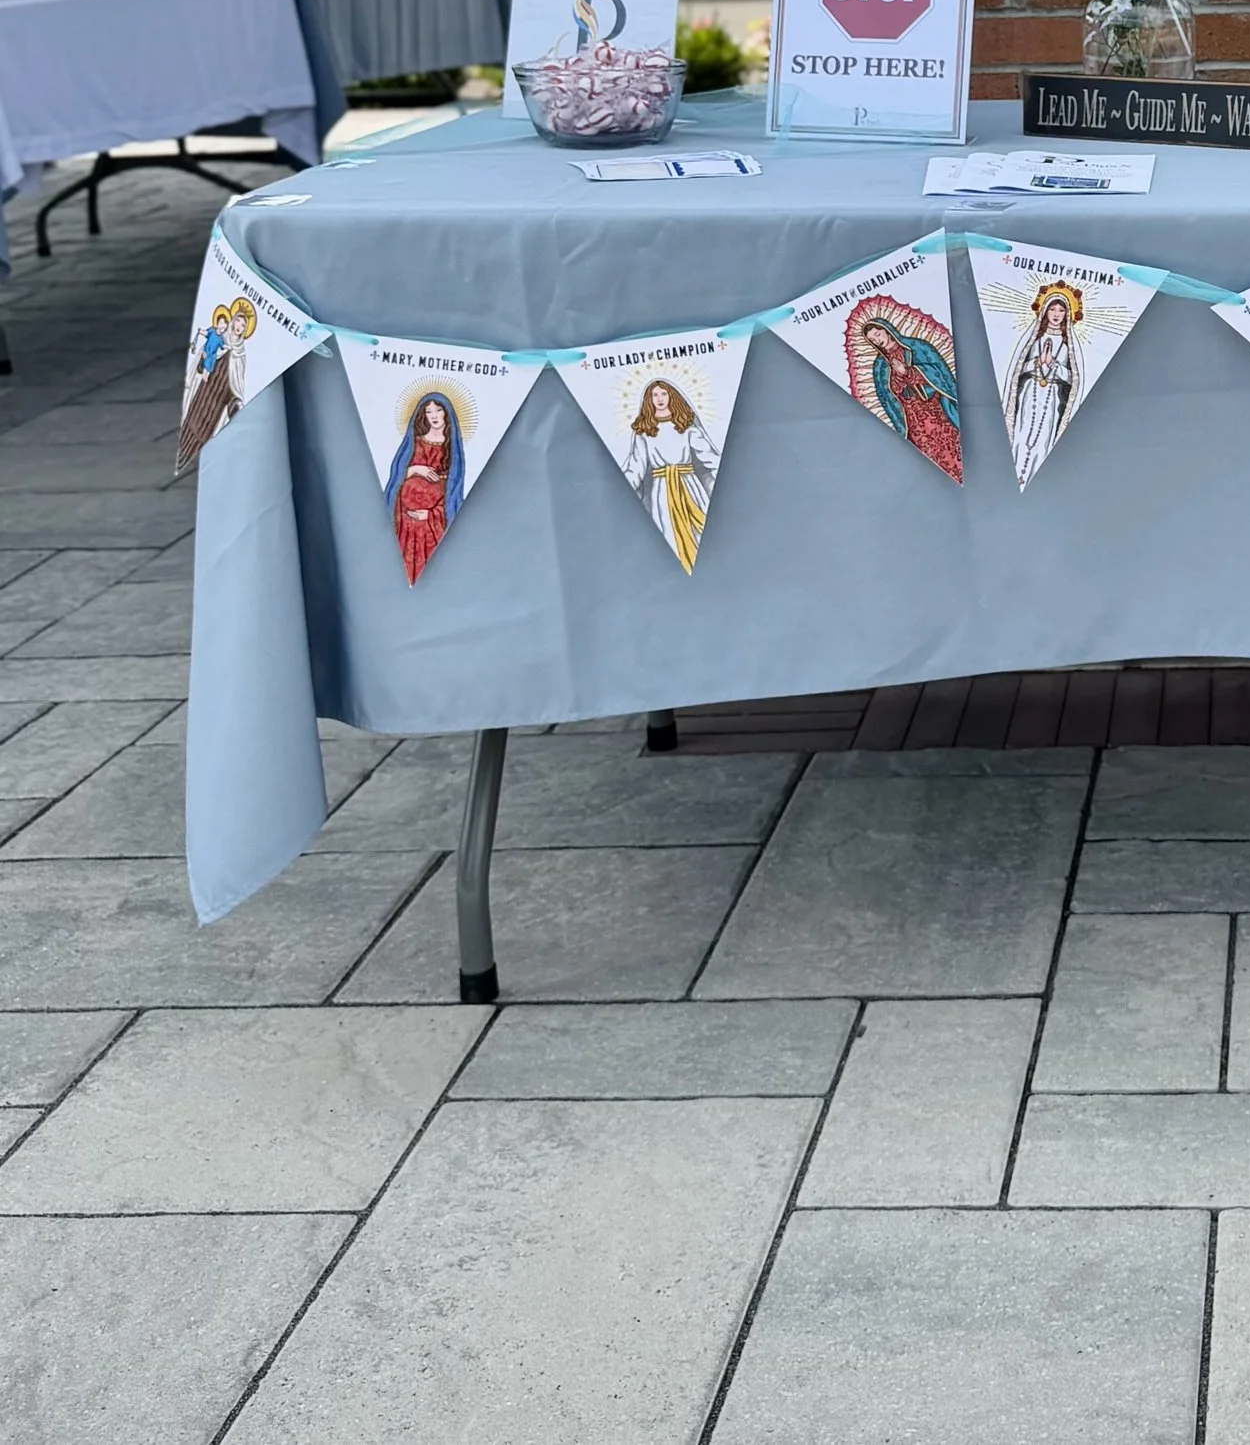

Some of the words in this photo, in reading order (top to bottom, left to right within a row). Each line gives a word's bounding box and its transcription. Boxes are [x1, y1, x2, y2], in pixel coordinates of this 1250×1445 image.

[791, 54, 858, 76] STOP
[863, 57, 946, 79] HERE!
[1013, 256, 1035, 270] OUR
[1037, 260, 1065, 276] LADY
[1074, 268, 1114, 286] FATIMA
[214, 248, 226, 267] OUR
[223, 261, 239, 284] LADY
[242, 282, 269, 311] MOUNT
[267, 304, 301, 337] CARMEL
[801, 305, 823, 322] OUR
[822, 291, 850, 312] LADY
[856, 257, 918, 296] GUADALUPE
[382, 351, 415, 368] MARY,
[418, 355, 465, 373] MOTHER
[474, 363, 498, 376] GOD
[593, 356, 616, 370] OUR
[618, 351, 646, 366] LADY
[656, 341, 715, 361] CHAMPION
